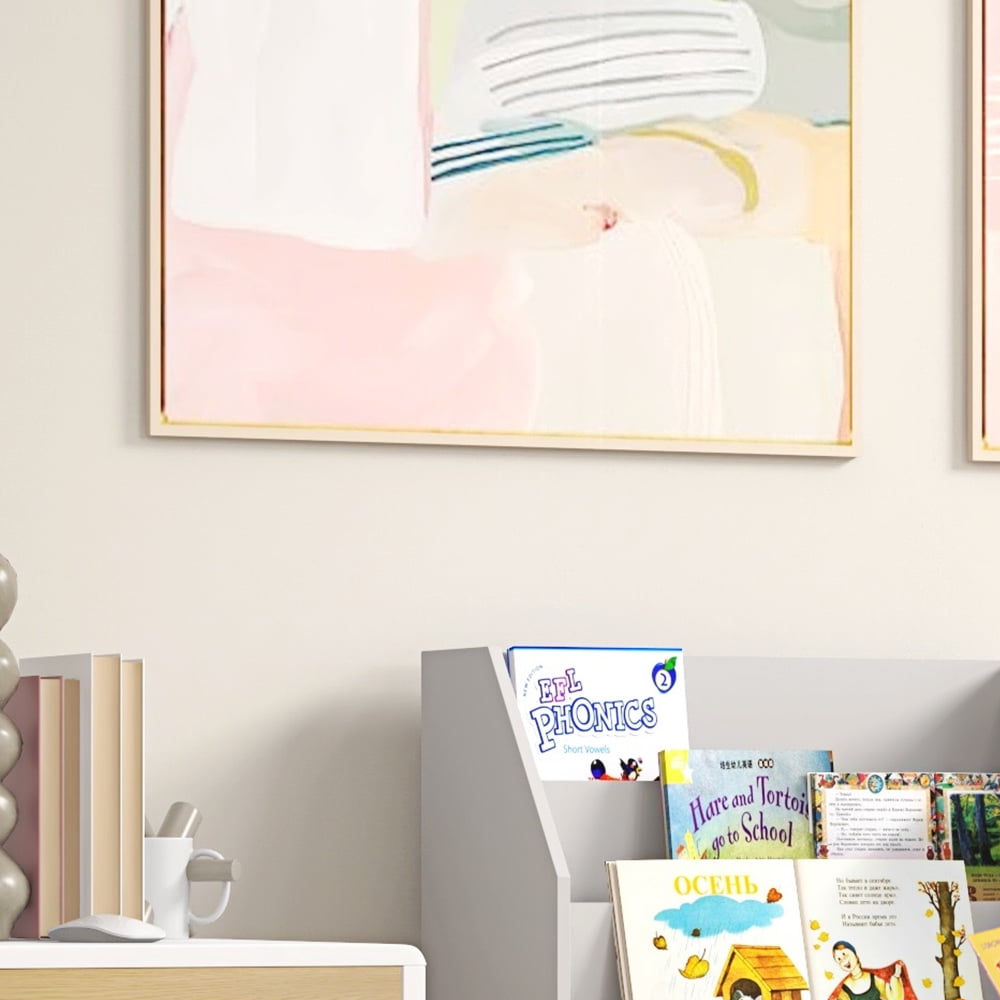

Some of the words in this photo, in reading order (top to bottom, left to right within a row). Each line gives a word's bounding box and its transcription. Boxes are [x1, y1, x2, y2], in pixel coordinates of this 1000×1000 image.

[537, 667, 583, 704] EFL
[659, 672, 669, 687] 2
[529, 696, 659, 753] PHONICS
[563, 744, 584, 754] Short
[584, 744, 611, 754] Vowels
[689, 795, 729, 833] Hare
[731, 784, 755, 809] and
[712, 834, 726, 859] go
[727, 825, 740, 845] to
[741, 811, 793, 847] School
[673, 875, 759, 895] ОСЕНЬ
